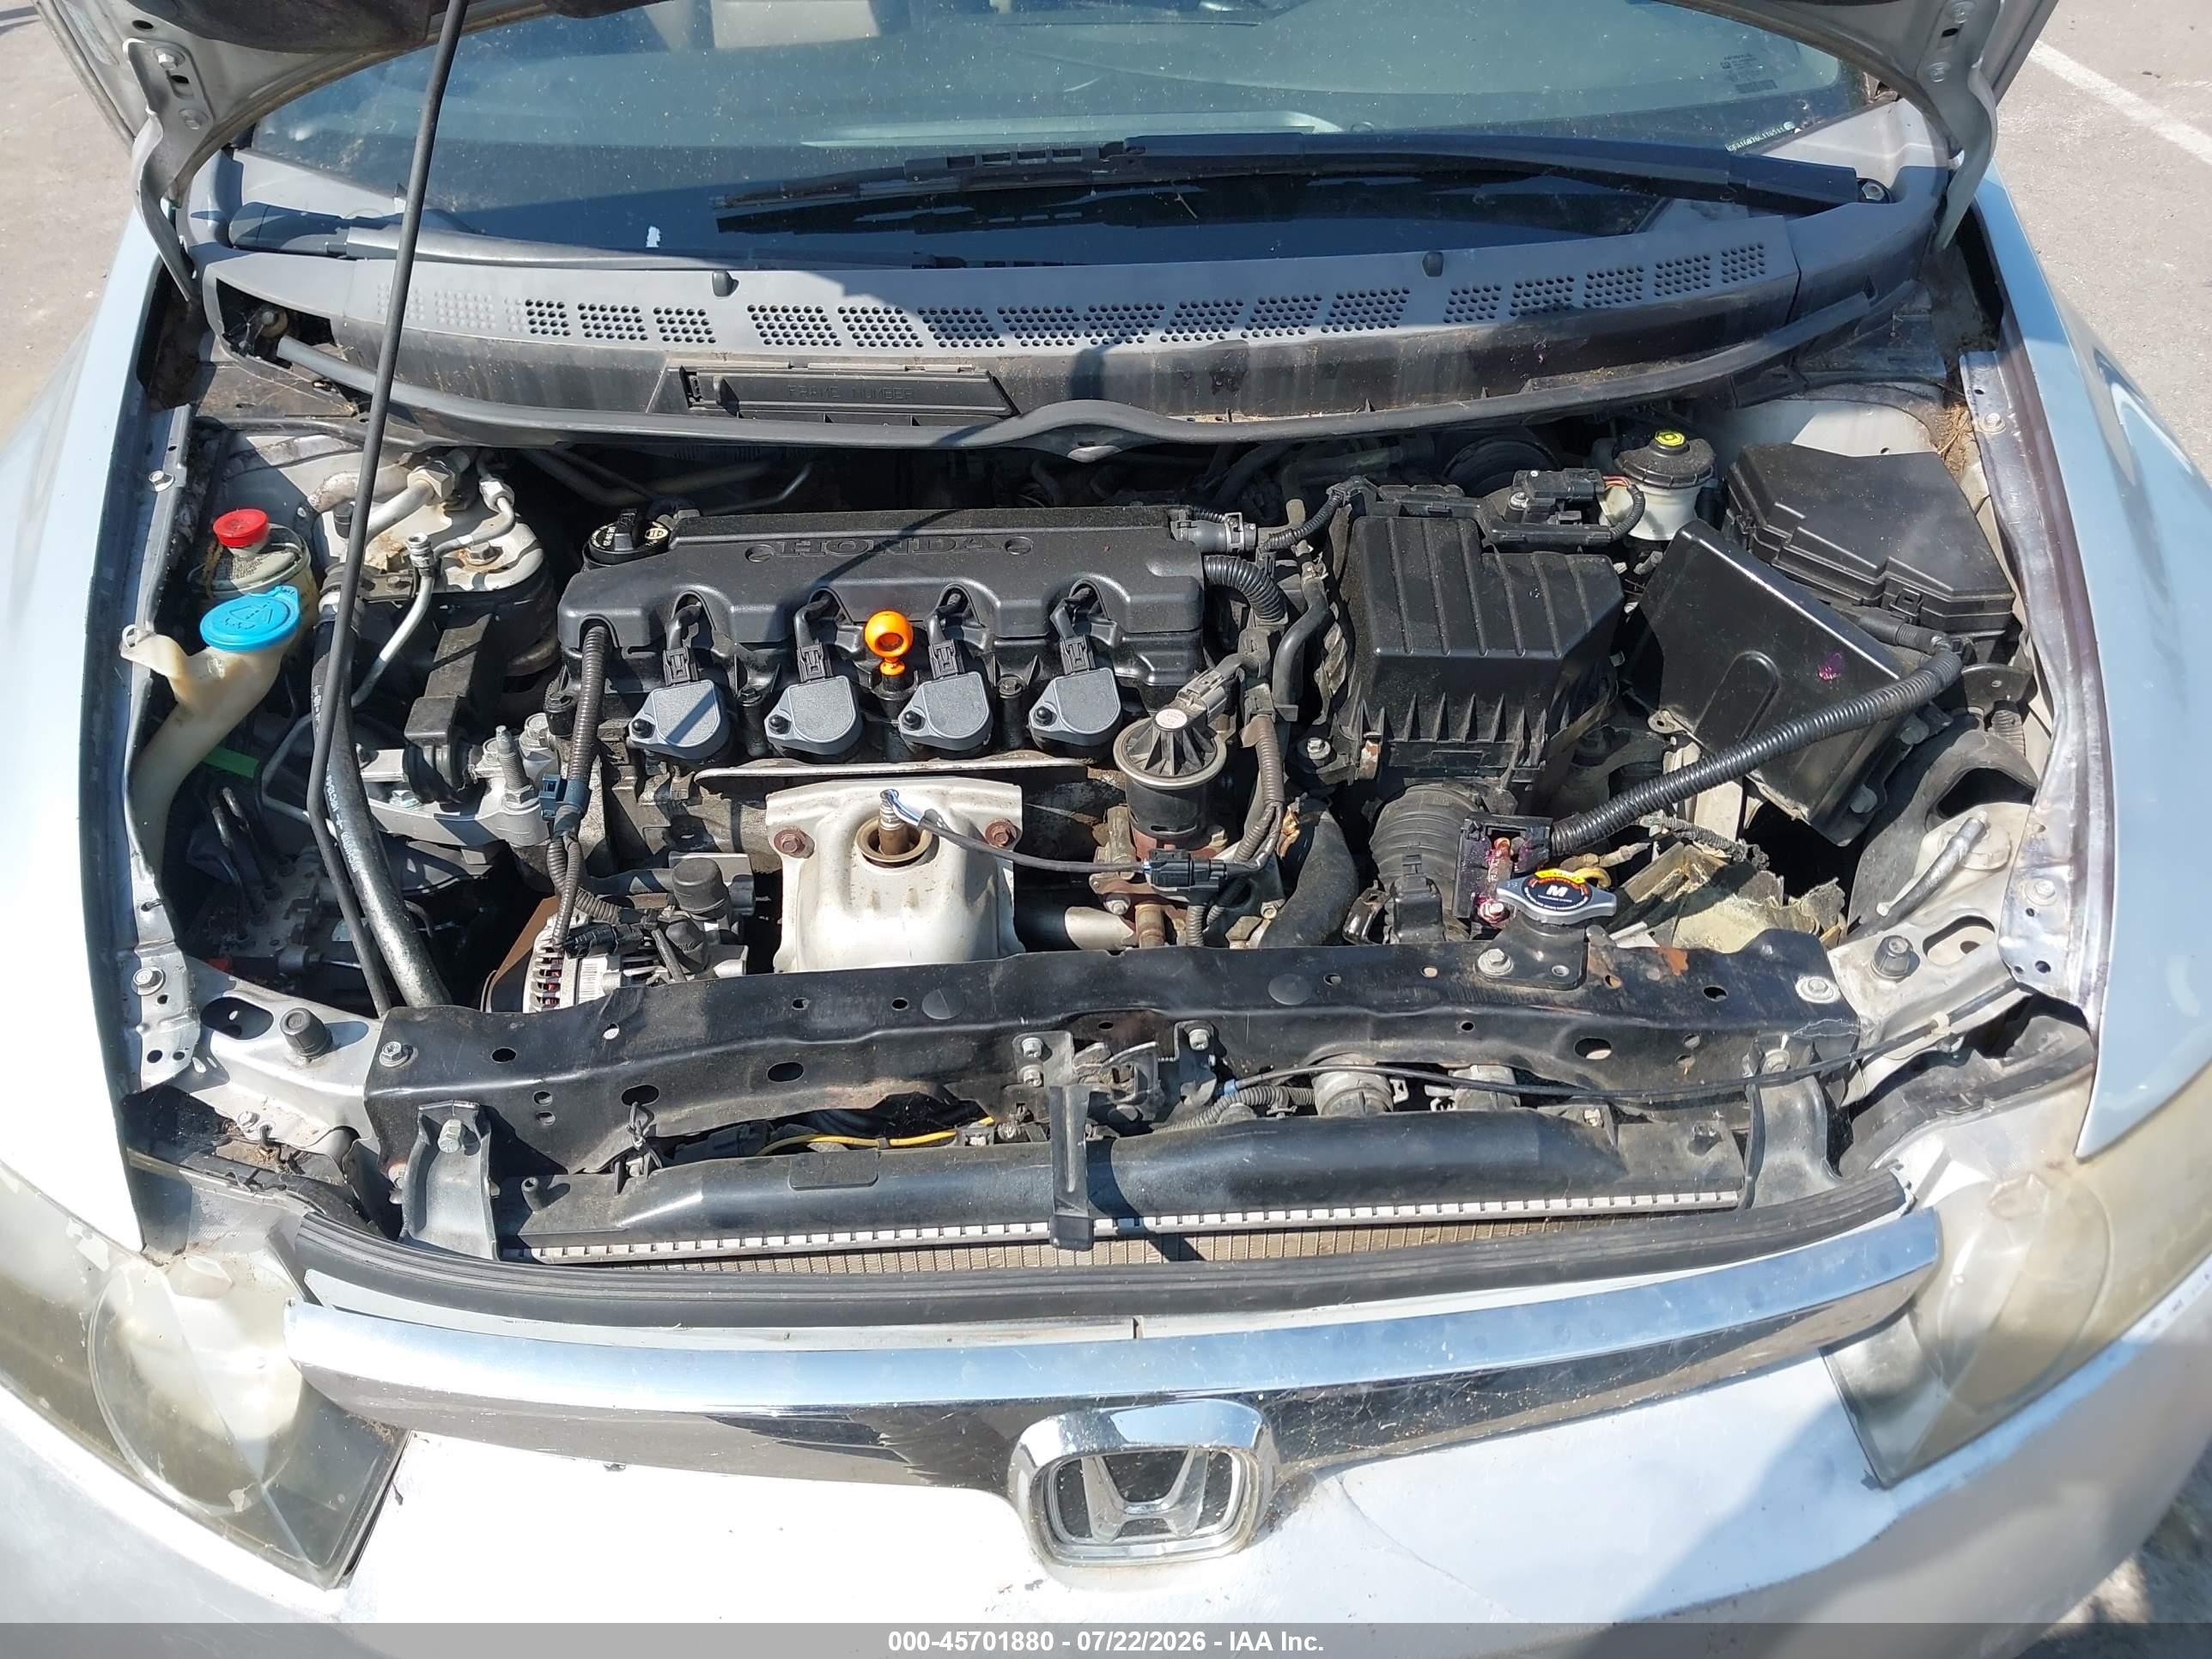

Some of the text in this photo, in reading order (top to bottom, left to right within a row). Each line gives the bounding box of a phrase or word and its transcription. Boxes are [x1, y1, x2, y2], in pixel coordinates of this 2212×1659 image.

[787, 385, 915, 400] FRAME NUMBER
[776, 538, 1003, 557] HONDA
